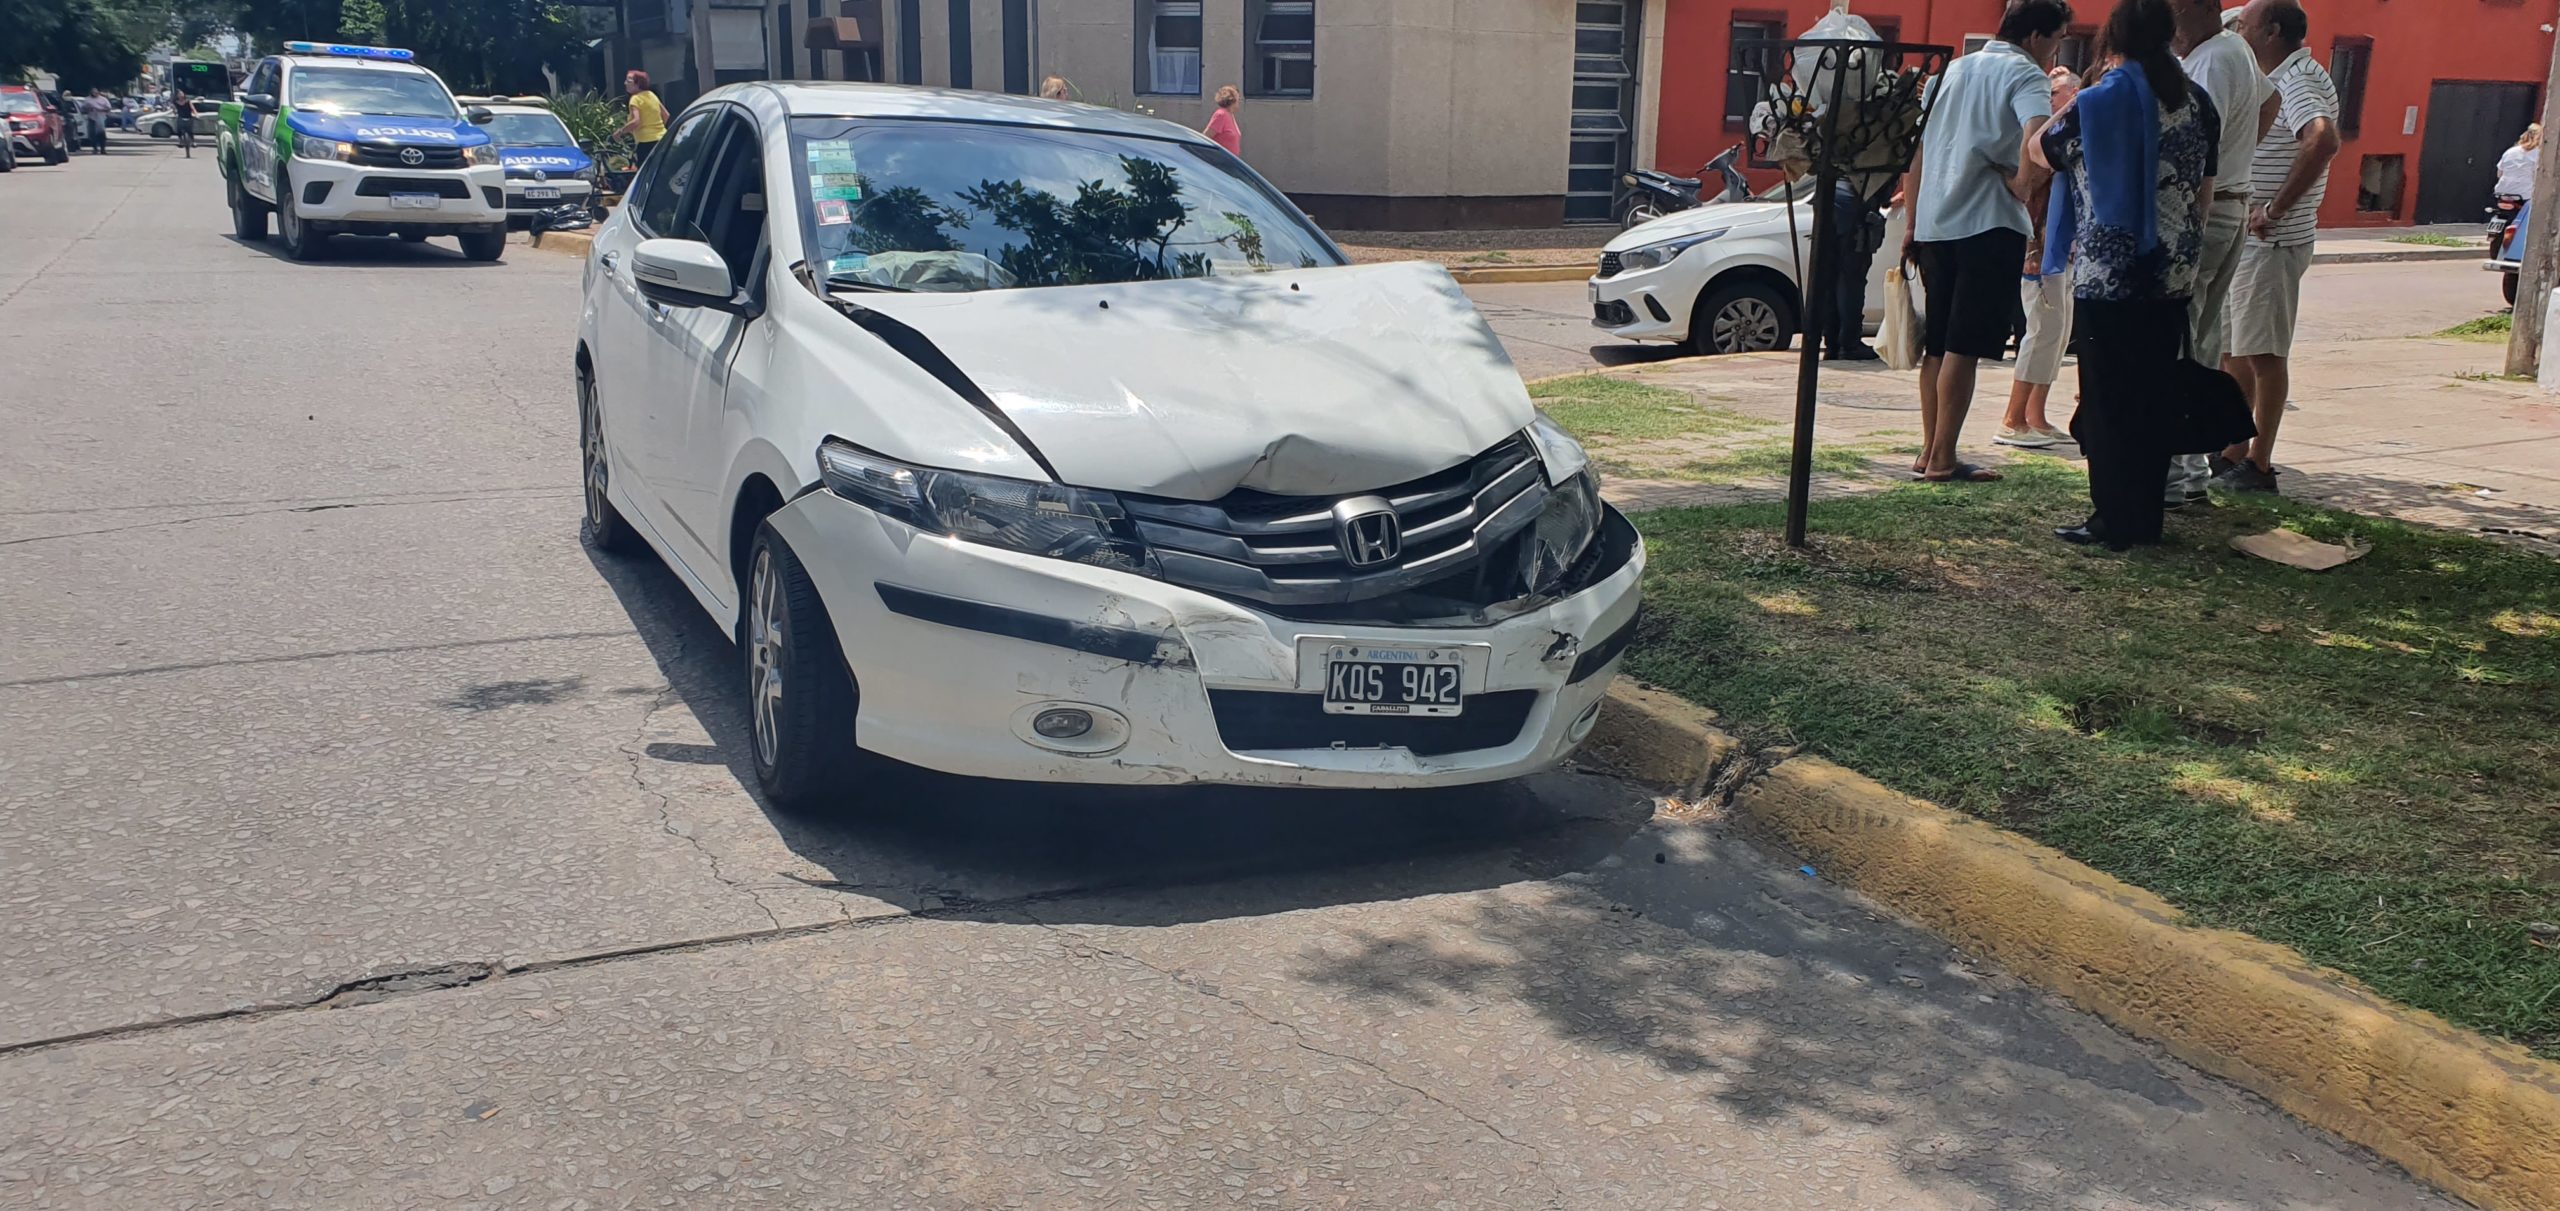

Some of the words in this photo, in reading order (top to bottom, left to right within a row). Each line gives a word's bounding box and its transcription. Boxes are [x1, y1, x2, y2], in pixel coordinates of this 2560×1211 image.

[191, 64, 208, 72] 520
[1366, 650, 1419, 661] ARGENTINA
[1330, 664, 1384, 701] KQS
[1402, 666, 1457, 703] 942
